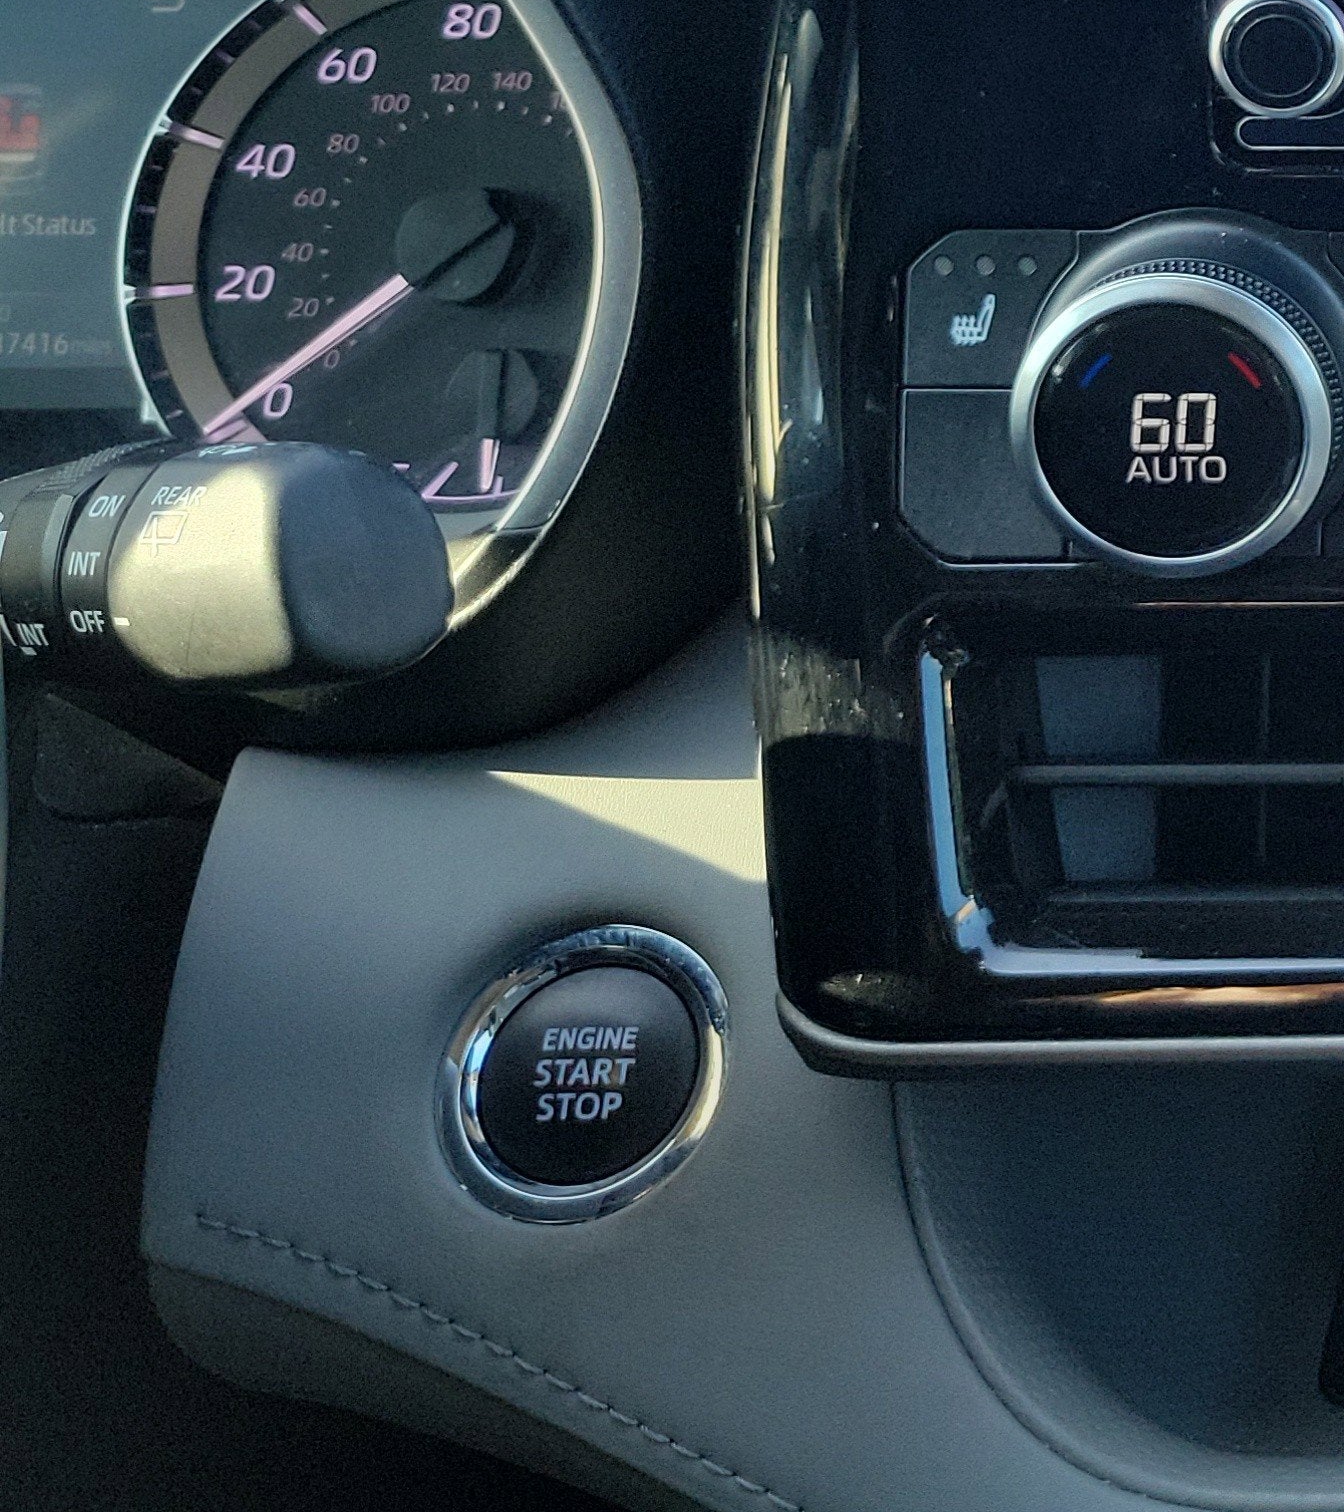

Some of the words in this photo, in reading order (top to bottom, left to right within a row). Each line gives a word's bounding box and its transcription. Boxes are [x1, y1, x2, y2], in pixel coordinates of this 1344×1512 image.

[443, 2, 502, 40] 80
[317, 46, 377, 84] 60
[431, 73, 471, 93] 120
[492, 70, 533, 91] 140
[370, 93, 411, 114] 100
[326, 133, 360, 154] 80
[236, 143, 296, 179] 40
[294, 187, 327, 208] 60
[22, 214, 96, 235] Status
[281, 242, 315, 263] 40
[215, 264, 276, 302] 20
[288, 297, 320, 319] 20
[262, 382, 294, 419] 0
[1129, 393, 1217, 453] 60
[1126, 455, 1227, 484] AUTO
[88, 494, 125, 518] ON
[150, 486, 208, 506] REAR
[67, 551, 101, 576] INT
[69, 610, 104, 633] OFF
[541, 1026, 640, 1052] ENGINE
[533, 1058, 636, 1087] START
[535, 1091, 623, 1122] STOP
